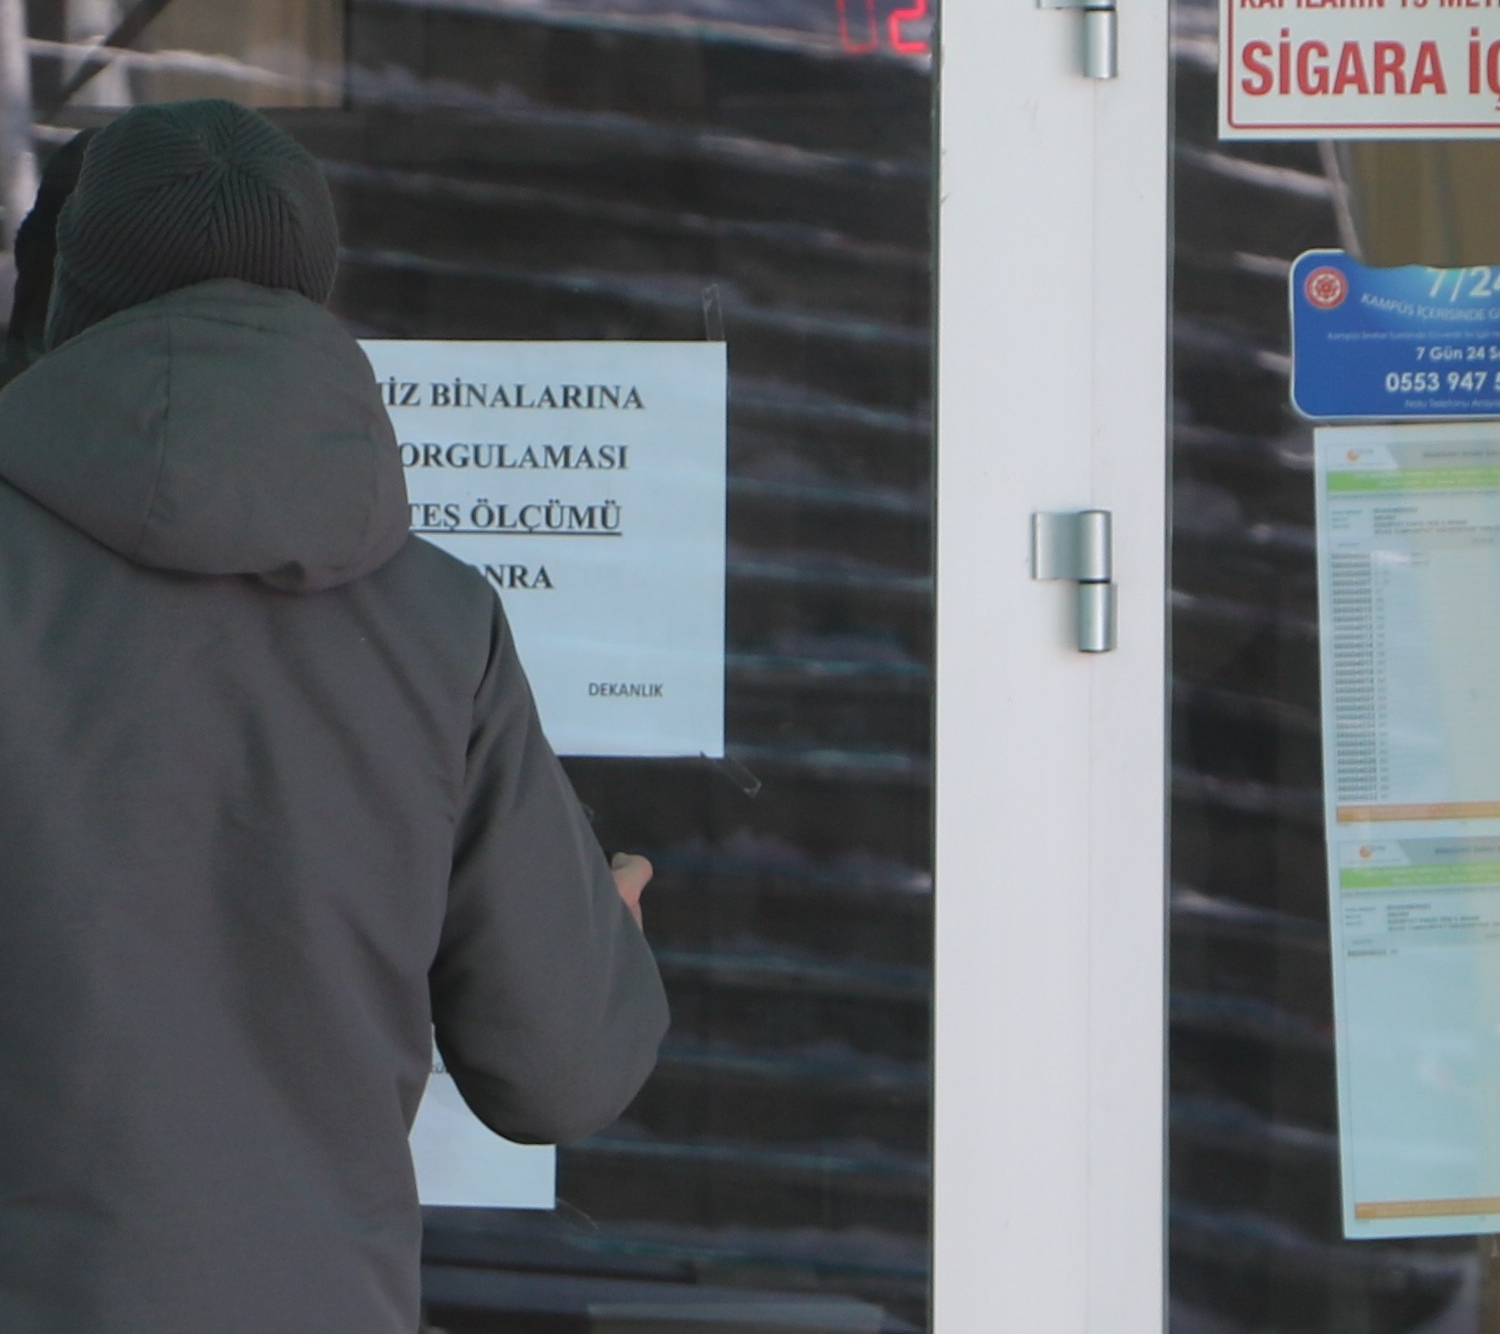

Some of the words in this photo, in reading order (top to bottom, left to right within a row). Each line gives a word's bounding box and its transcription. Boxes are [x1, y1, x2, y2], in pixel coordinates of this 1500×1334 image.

[1241, 28, 1447, 97] SİGARA
[1416, 346, 1426, 360] 7
[1429, 346, 1462, 360] Gün
[1466, 346, 1486, 360] 24
[431, 376, 645, 409] BİNALARINA
[1385, 371, 1440, 393] 0553
[1447, 371, 1488, 391] 947
[470, 498, 622, 533] ÖLÇÜMÜ
[588, 682, 663, 697] DEKANLIK
